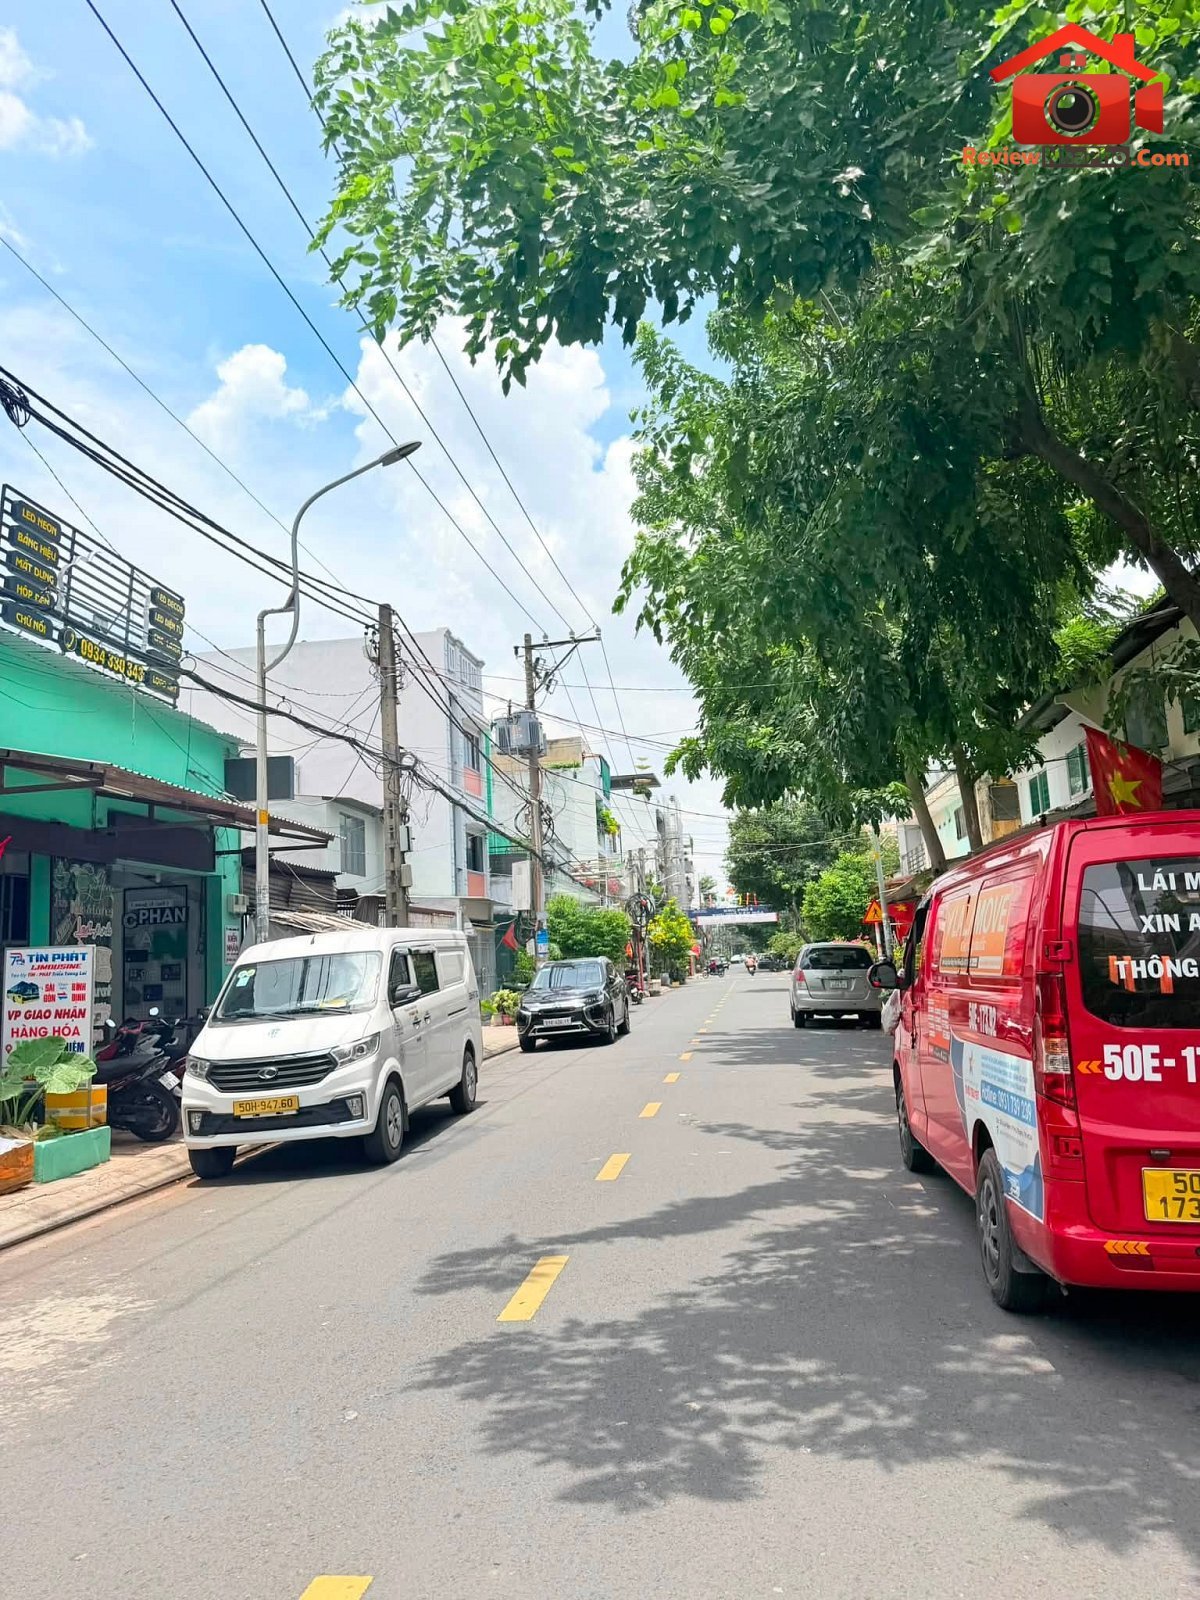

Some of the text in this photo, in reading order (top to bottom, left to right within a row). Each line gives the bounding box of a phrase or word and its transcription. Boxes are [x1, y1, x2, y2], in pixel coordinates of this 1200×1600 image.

[22, 507, 58, 537] LED NEON
[81, 638, 106, 665] 0934
[126, 661, 145, 682] 343
[1137, 867, 1177, 891] LÁI
[1139, 913, 1181, 934] XIN
[26, 949, 88, 963] TÍN PHÁT
[31, 963, 82, 971] LIMOUSINE
[1114, 954, 1200, 980] THÔNG
[8, 1005, 86, 1022] VP GIAO NHẬN
[11, 1022, 80, 1038] HÀNG HÓA
[238, 1098, 293, 1113] 50H-947.60
